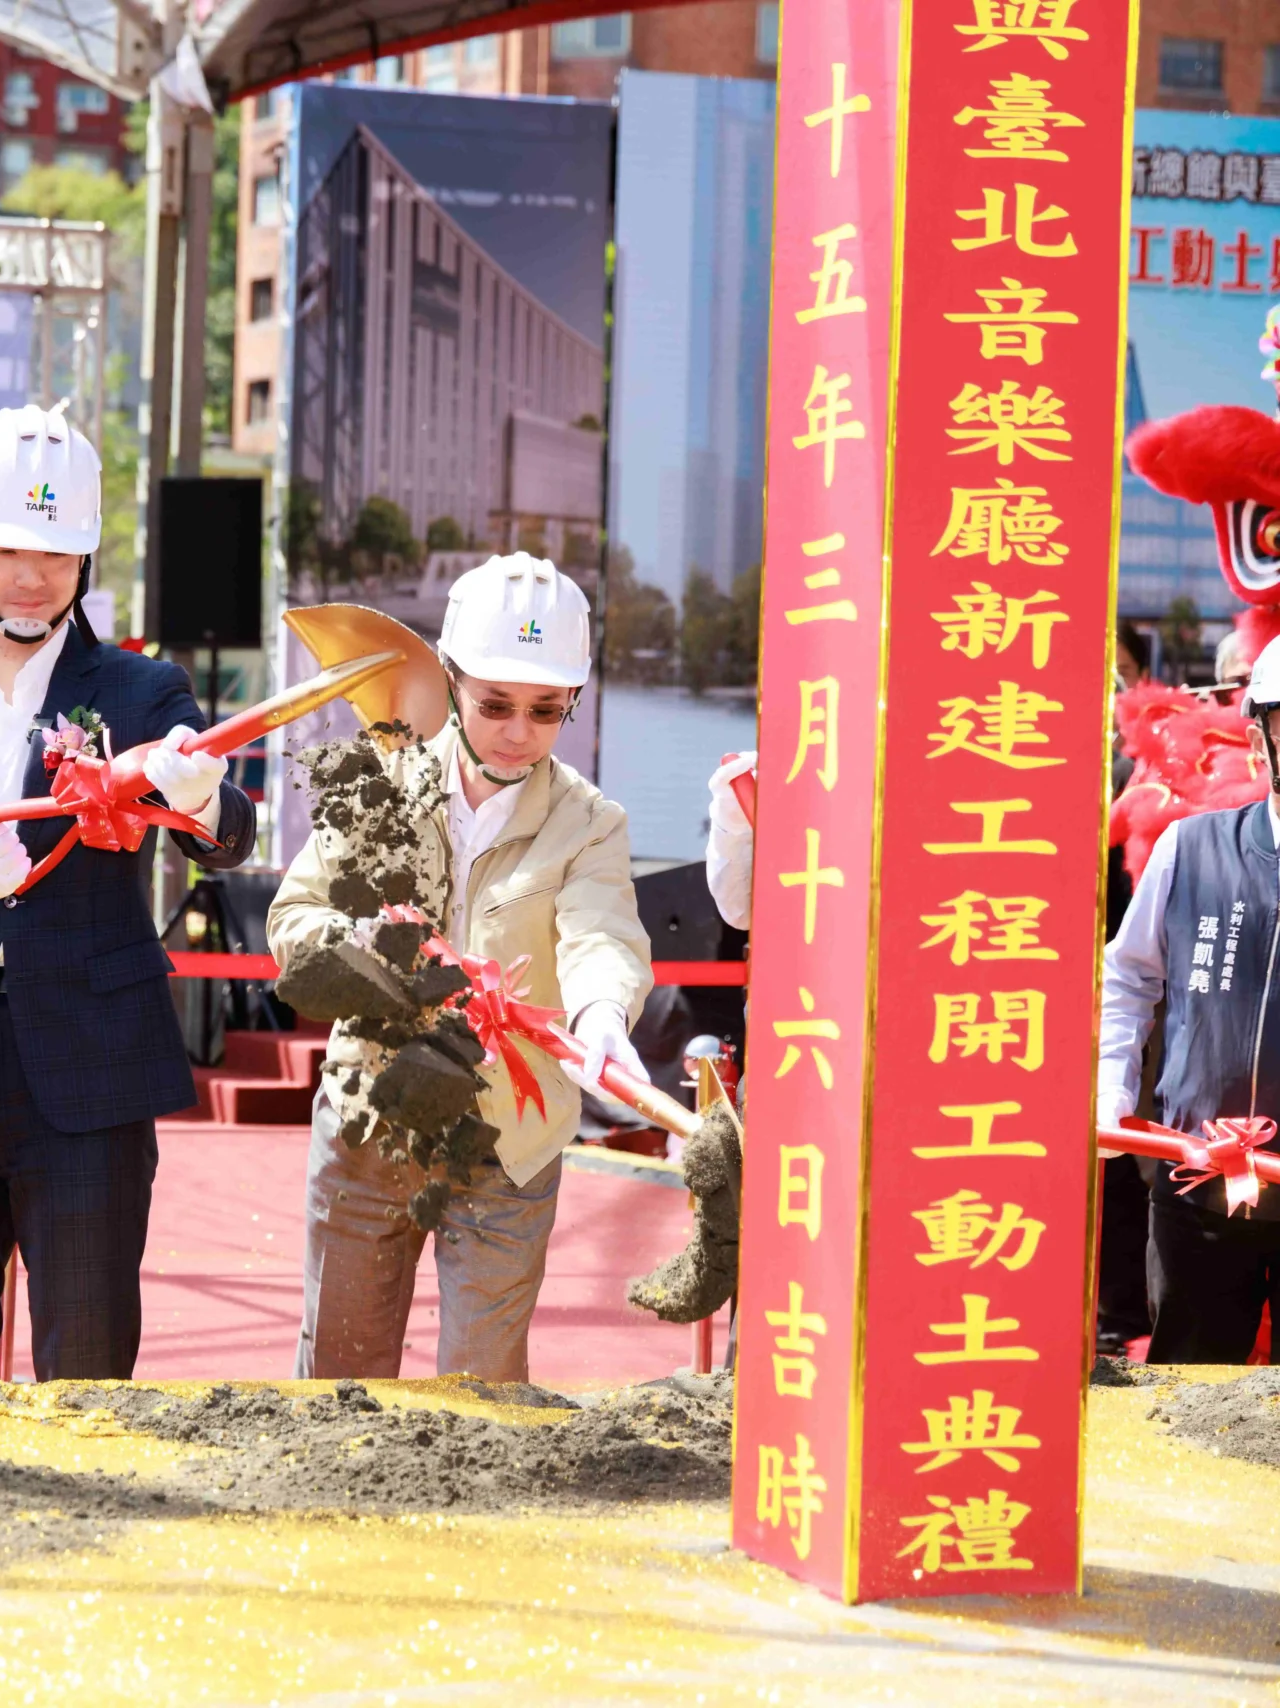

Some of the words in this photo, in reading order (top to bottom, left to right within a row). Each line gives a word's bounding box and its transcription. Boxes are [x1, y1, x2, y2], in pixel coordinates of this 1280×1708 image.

[25, 502, 57, 513] TAIPEI
[517, 635, 543, 644] TAIPEI
[756, 62, 872, 1560] 十五年三月十六日吉時
[896, 0, 1091, 1574] 與臺北音樂廳新建工程開工動土典禮
[1187, 915, 1220, 994] 張凱堯
